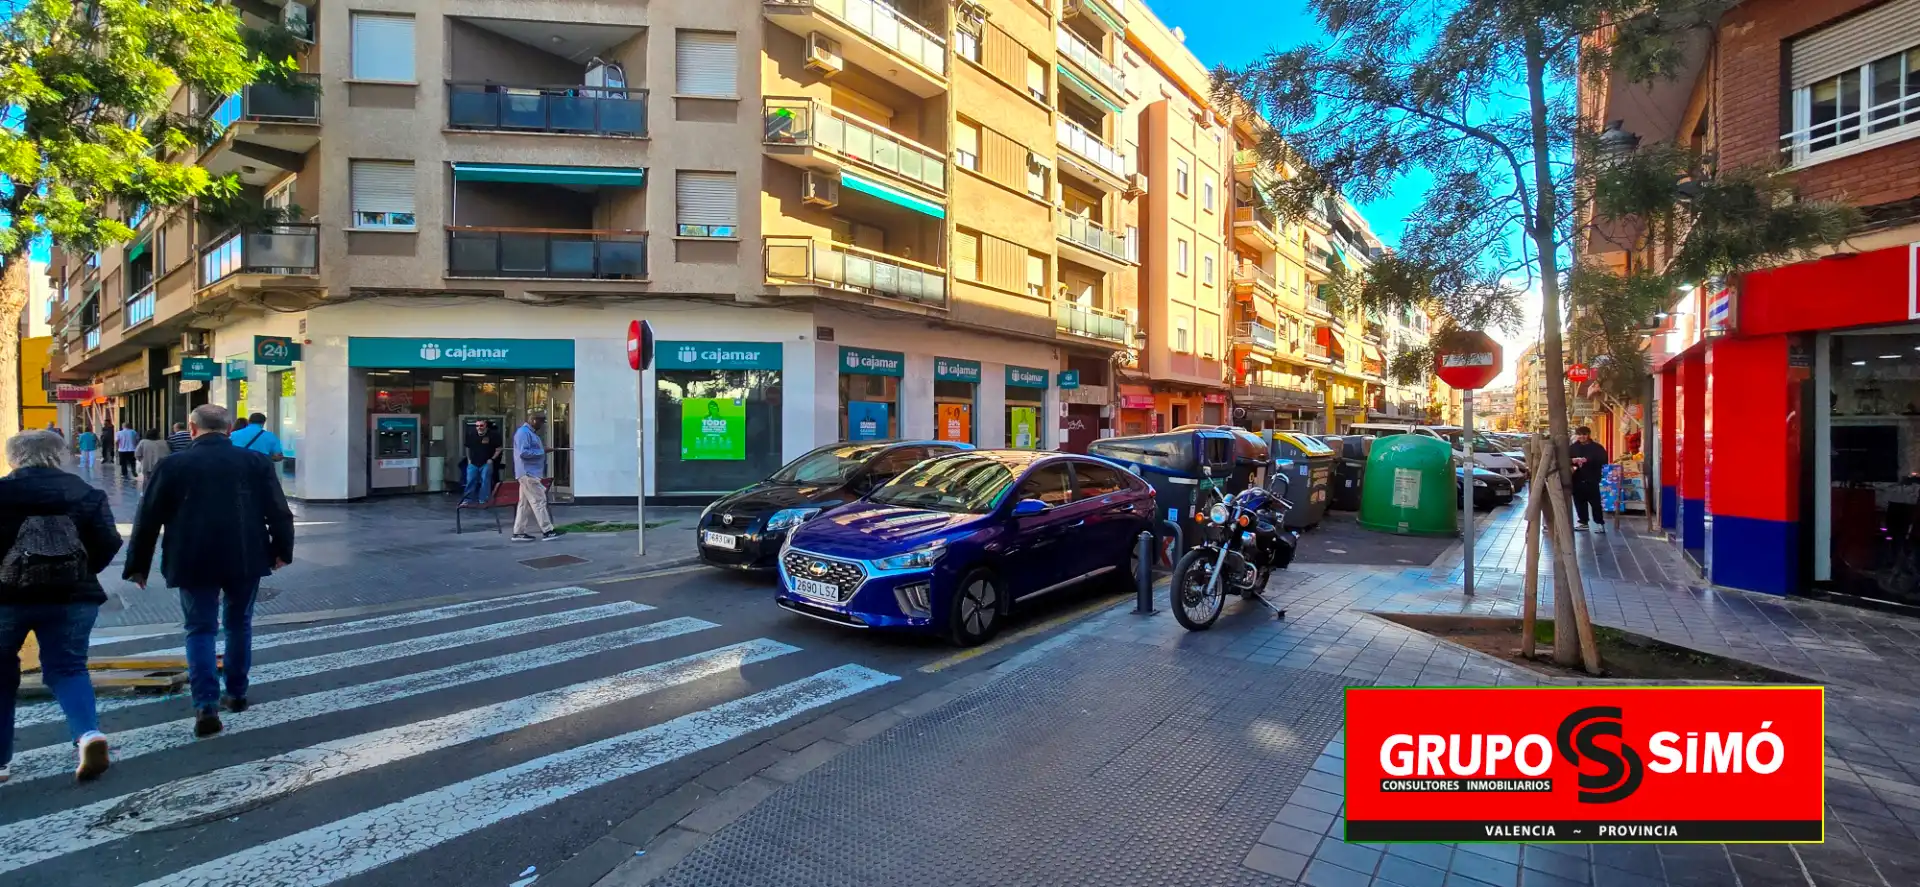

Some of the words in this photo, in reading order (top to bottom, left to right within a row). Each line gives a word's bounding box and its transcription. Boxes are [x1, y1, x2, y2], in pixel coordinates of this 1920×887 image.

[445, 344, 509, 361] cajamar
[701, 348, 760, 363] cajamar
[861, 355, 898, 370] cajamar
[1569, 365, 1588, 375] ria
[949, 364, 978, 377] cajamar
[1020, 371, 1043, 383] cajamar
[797, 579, 817, 594] 2690
[820, 584, 836, 599] LSZ
